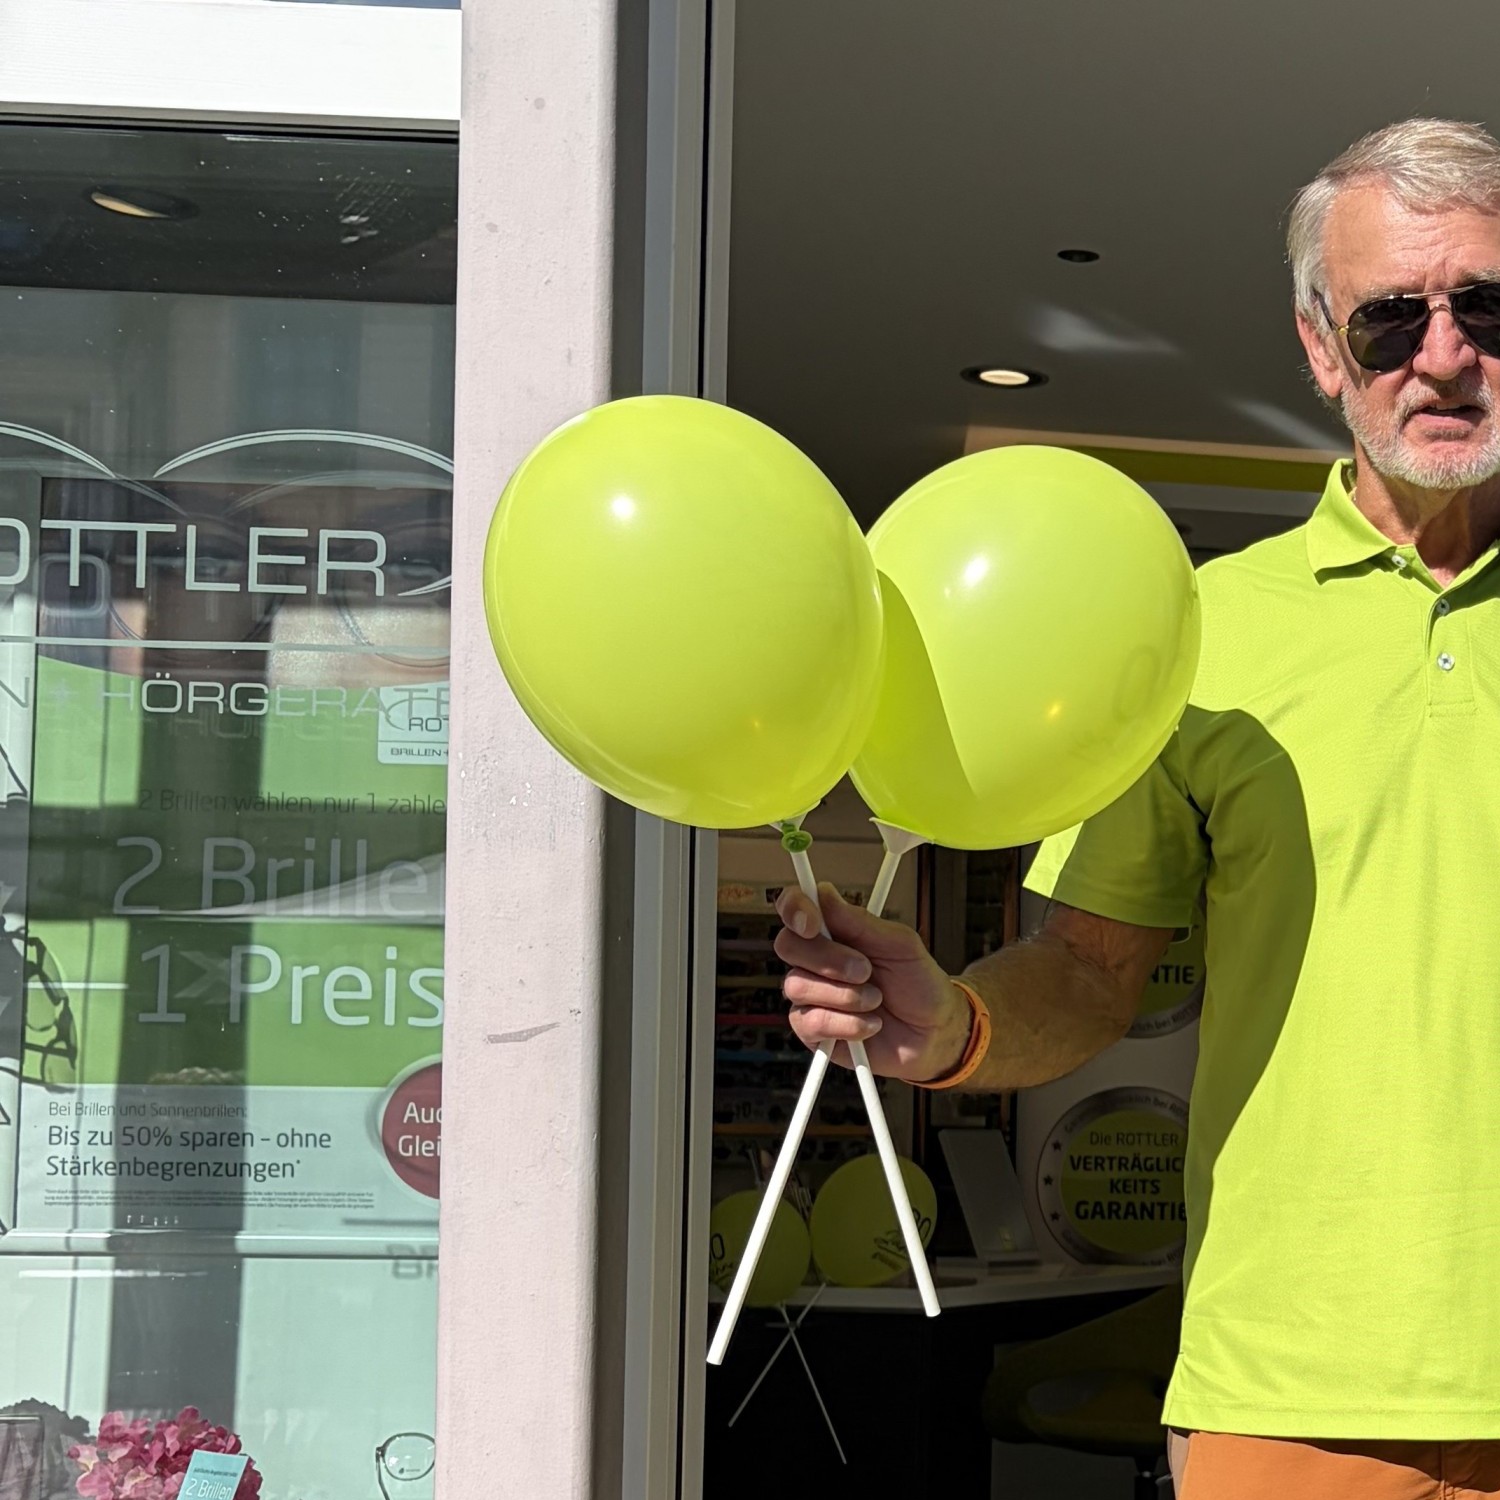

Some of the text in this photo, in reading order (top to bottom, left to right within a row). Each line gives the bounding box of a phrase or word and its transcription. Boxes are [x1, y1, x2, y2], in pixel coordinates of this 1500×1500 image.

[160, 789, 226, 812] Brillen
[323, 796, 359, 814] nur
[113, 836, 446, 918] 2 Brille
[138, 944, 444, 1028] 1 Preis
[48, 1102, 72, 1117] Bei
[75, 1102, 116, 1117] Brillen
[119, 1102, 146, 1118] und
[48, 1125, 81, 1147] Bis
[87, 1129, 113, 1147] zu
[121, 1126, 173, 1148] 50%
[179, 1129, 254, 1152] sparen
[276, 1128, 332, 1149] ohne
[1089, 1131, 1179, 1147] Die ROTTLER
[1069, 1153, 1185, 1173] VERTRÄGLIC
[1109, 1178, 1161, 1195] KEITS
[186, 1478, 232, 1500] 2 Brillen
